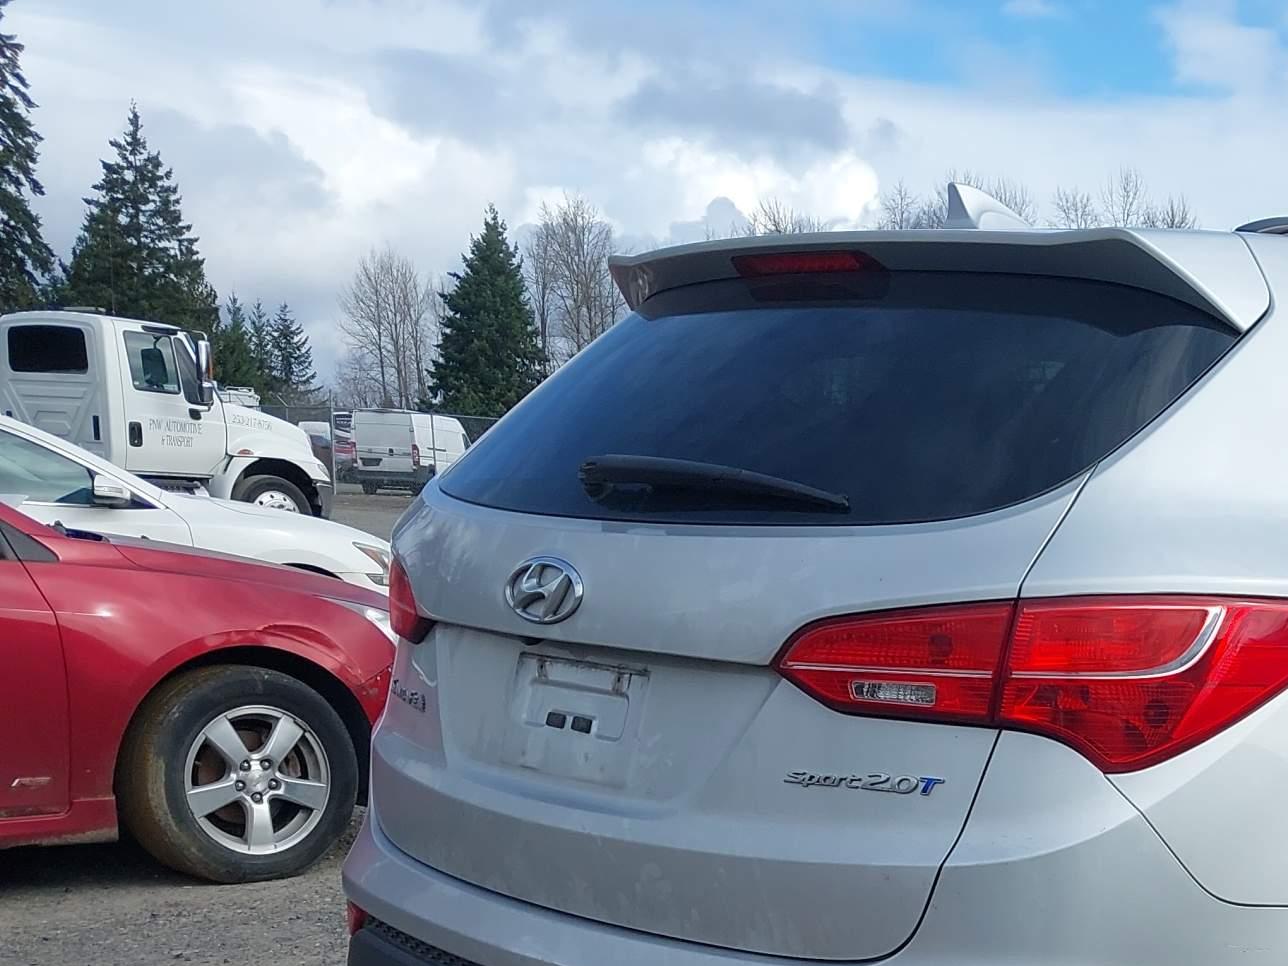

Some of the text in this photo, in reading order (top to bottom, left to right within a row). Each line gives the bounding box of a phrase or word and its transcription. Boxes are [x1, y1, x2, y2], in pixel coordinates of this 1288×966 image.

[149, 418, 203, 434] PNW AUTOMOTIVE
[166, 434, 194, 448] TRANSPORT
[783, 771, 861, 788] Sport
